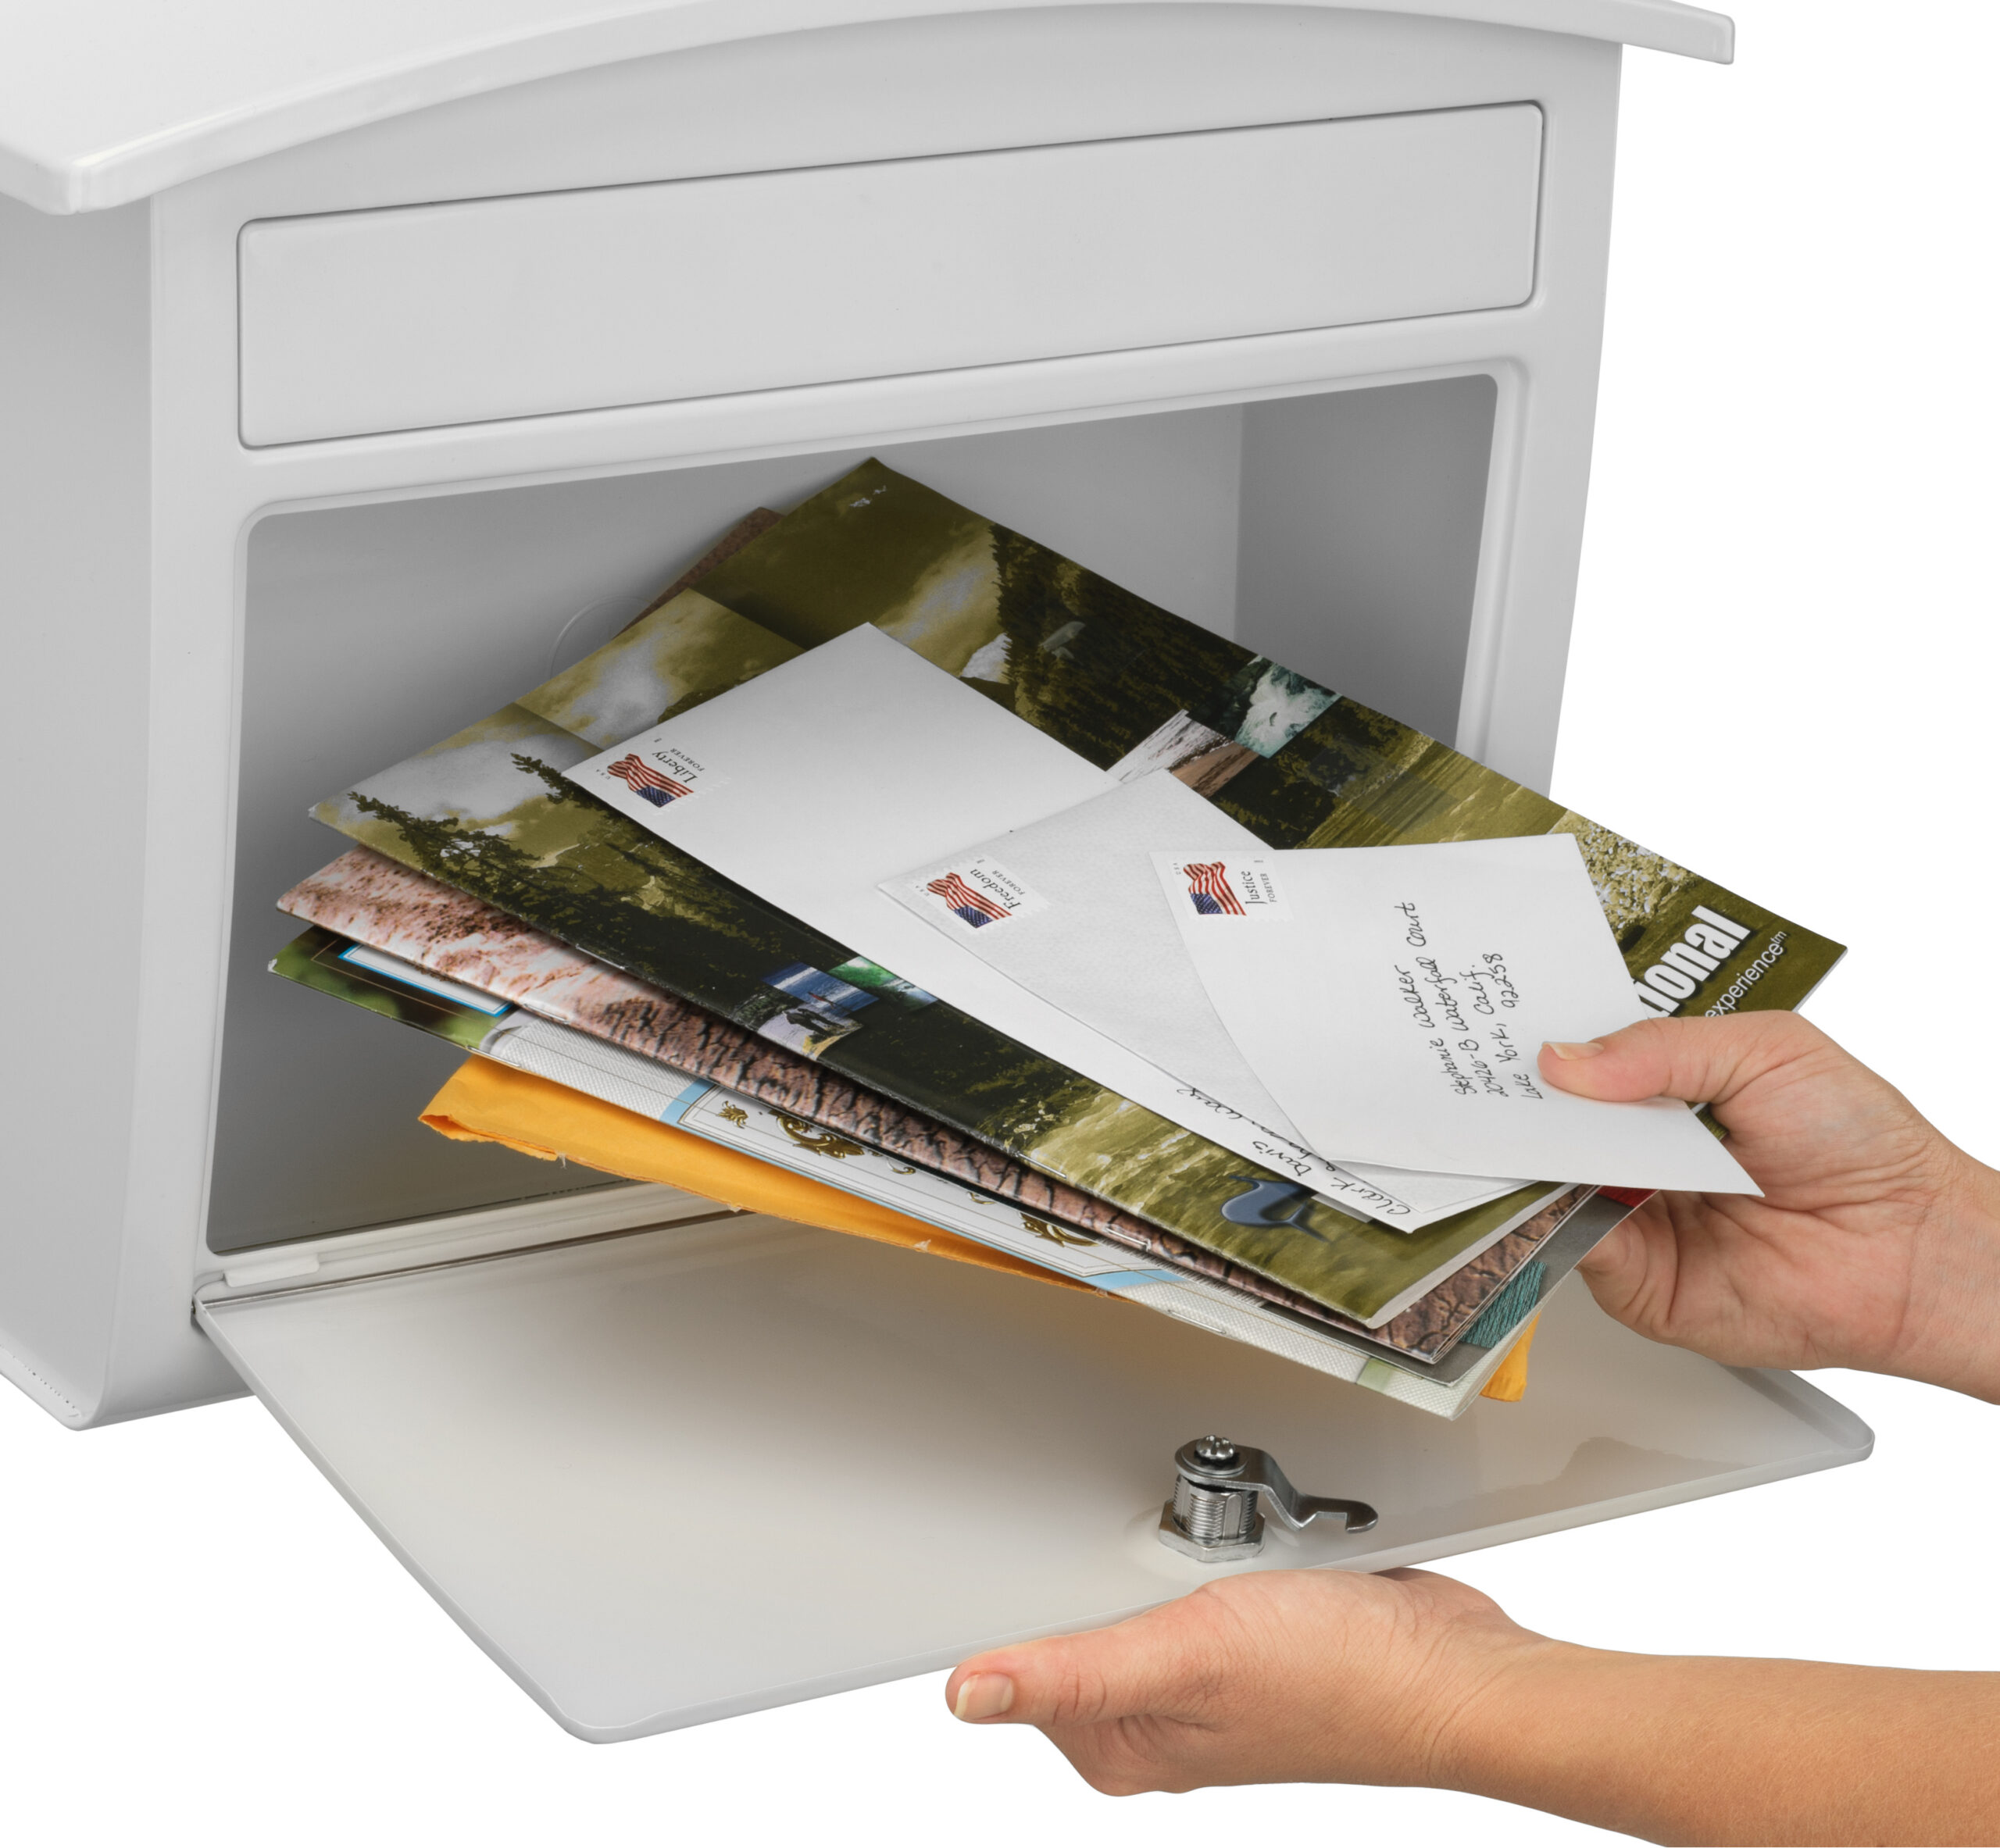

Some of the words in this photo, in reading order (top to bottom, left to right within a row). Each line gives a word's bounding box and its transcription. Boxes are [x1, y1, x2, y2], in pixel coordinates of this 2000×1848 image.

[651, 750, 698, 783] Liberty
[670, 747, 705, 772] FOREVER
[970, 868, 1023, 910] Freedom
[991, 869, 1026, 896] FOREVER
[1241, 871, 1268, 904] Justice
[1260, 872, 1277, 903] FOREVER
[1394, 901, 1427, 947] Court
[1459, 964, 1495, 1015] Calif.
[1482, 953, 1520, 1008] 92258
[1429, 1037, 1478, 1095] Stephanie
[1457, 1039, 1509, 1097] 20426-B
[1252, 1140, 1313, 1178] Davis
[1330, 1176, 1412, 1216] Clark
